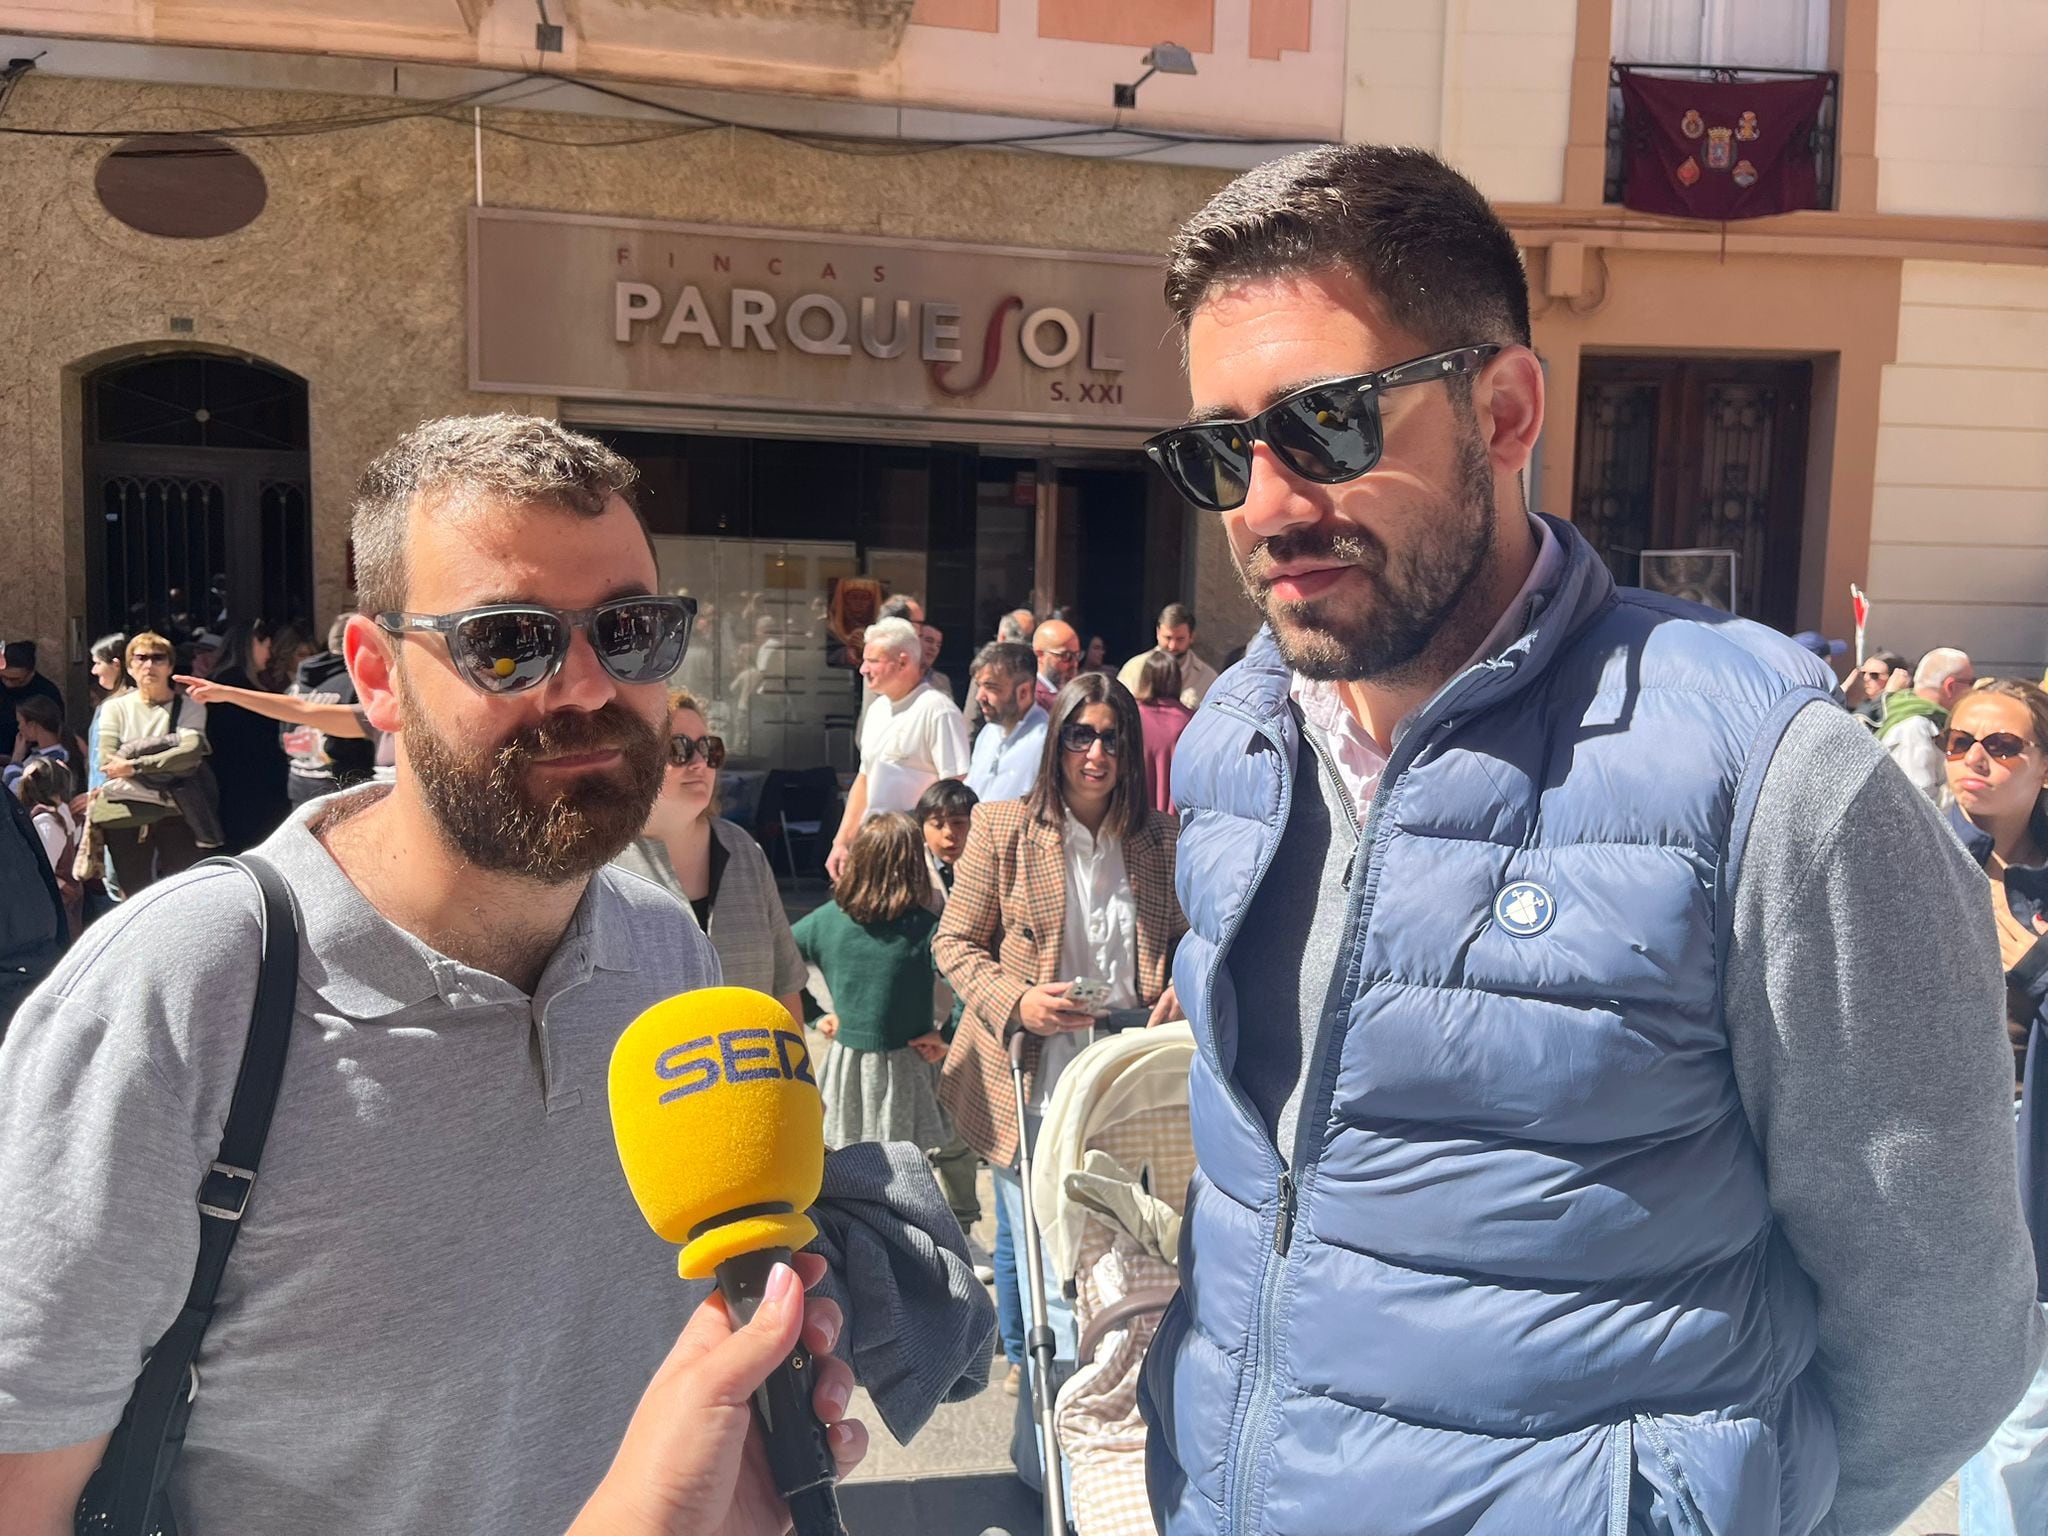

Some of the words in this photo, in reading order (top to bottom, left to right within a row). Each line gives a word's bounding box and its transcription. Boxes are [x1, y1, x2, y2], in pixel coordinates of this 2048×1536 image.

[616, 248, 886, 283] FINCAS
[1050, 381, 1070, 402] S.
[1079, 383, 1123, 404] XXI
